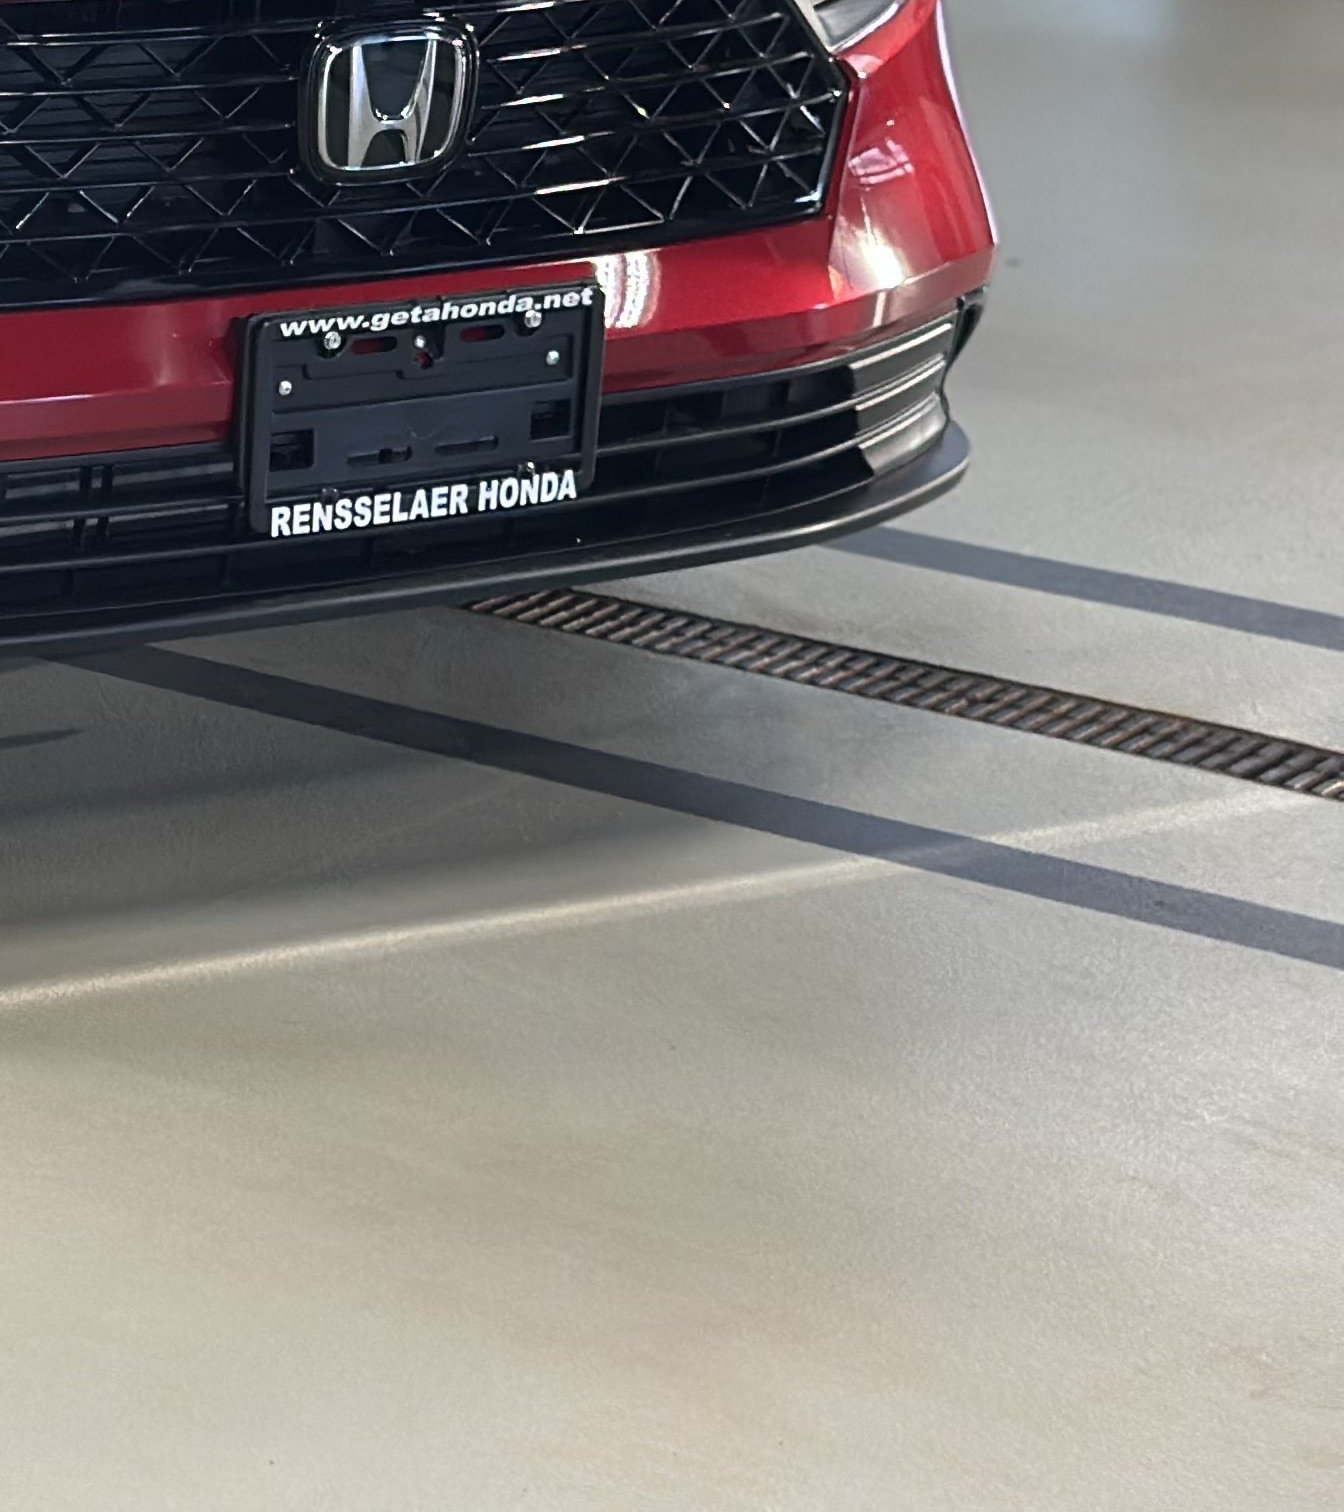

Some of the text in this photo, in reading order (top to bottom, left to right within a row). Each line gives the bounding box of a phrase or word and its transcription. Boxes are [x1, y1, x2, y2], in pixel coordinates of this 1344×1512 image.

[279, 287, 594, 337] www.getahonda.net
[270, 469, 578, 538] RENSSELAER HONDA
